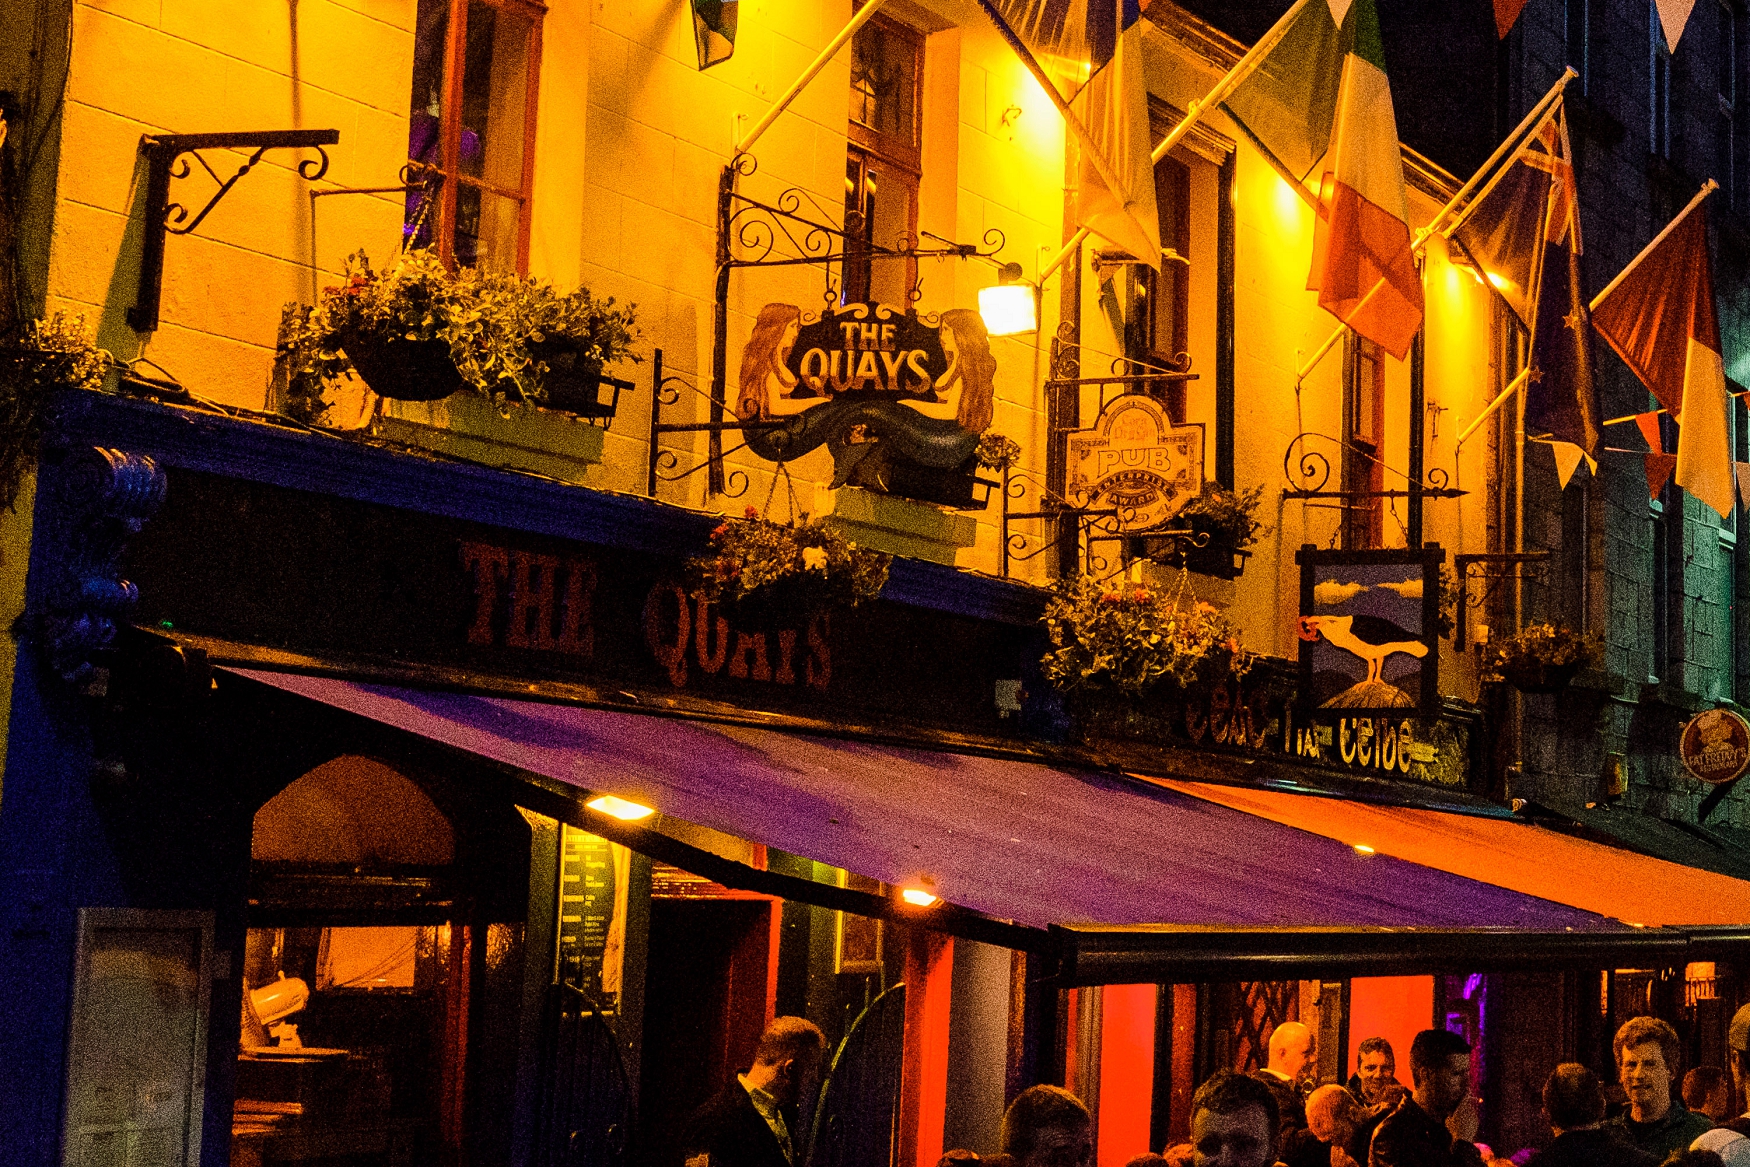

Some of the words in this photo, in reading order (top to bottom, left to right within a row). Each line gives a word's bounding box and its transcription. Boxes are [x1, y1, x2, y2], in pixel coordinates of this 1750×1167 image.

[839, 321, 897, 350] THE
[800, 347, 931, 399] QUAYS
[1097, 447, 1172, 479] PUB
[1109, 491, 1155, 505] AWARD
[458, 540, 599, 657] THE
